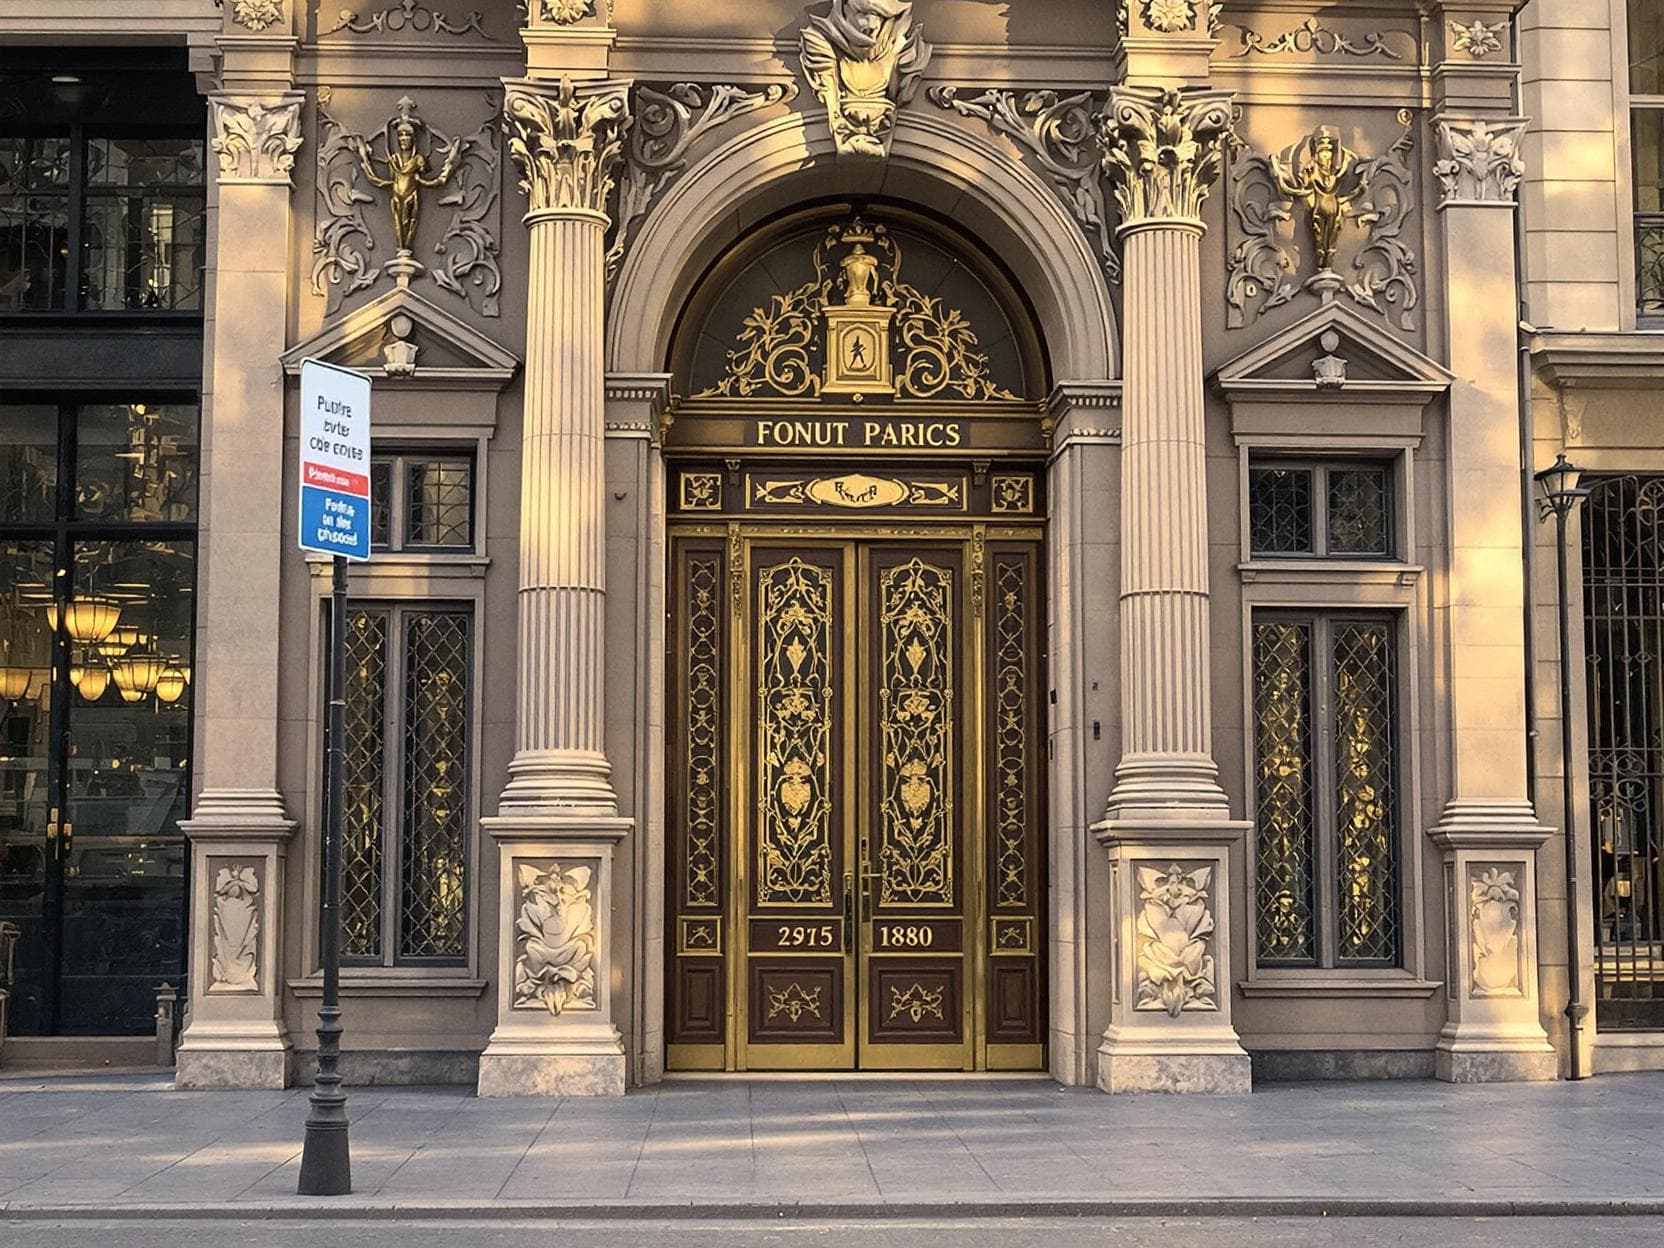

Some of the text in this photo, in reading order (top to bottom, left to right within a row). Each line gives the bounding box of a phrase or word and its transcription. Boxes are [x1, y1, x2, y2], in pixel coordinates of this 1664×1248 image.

[757, 420, 961, 447] FONUT PARICS
[880, 926, 933, 946] 1880
